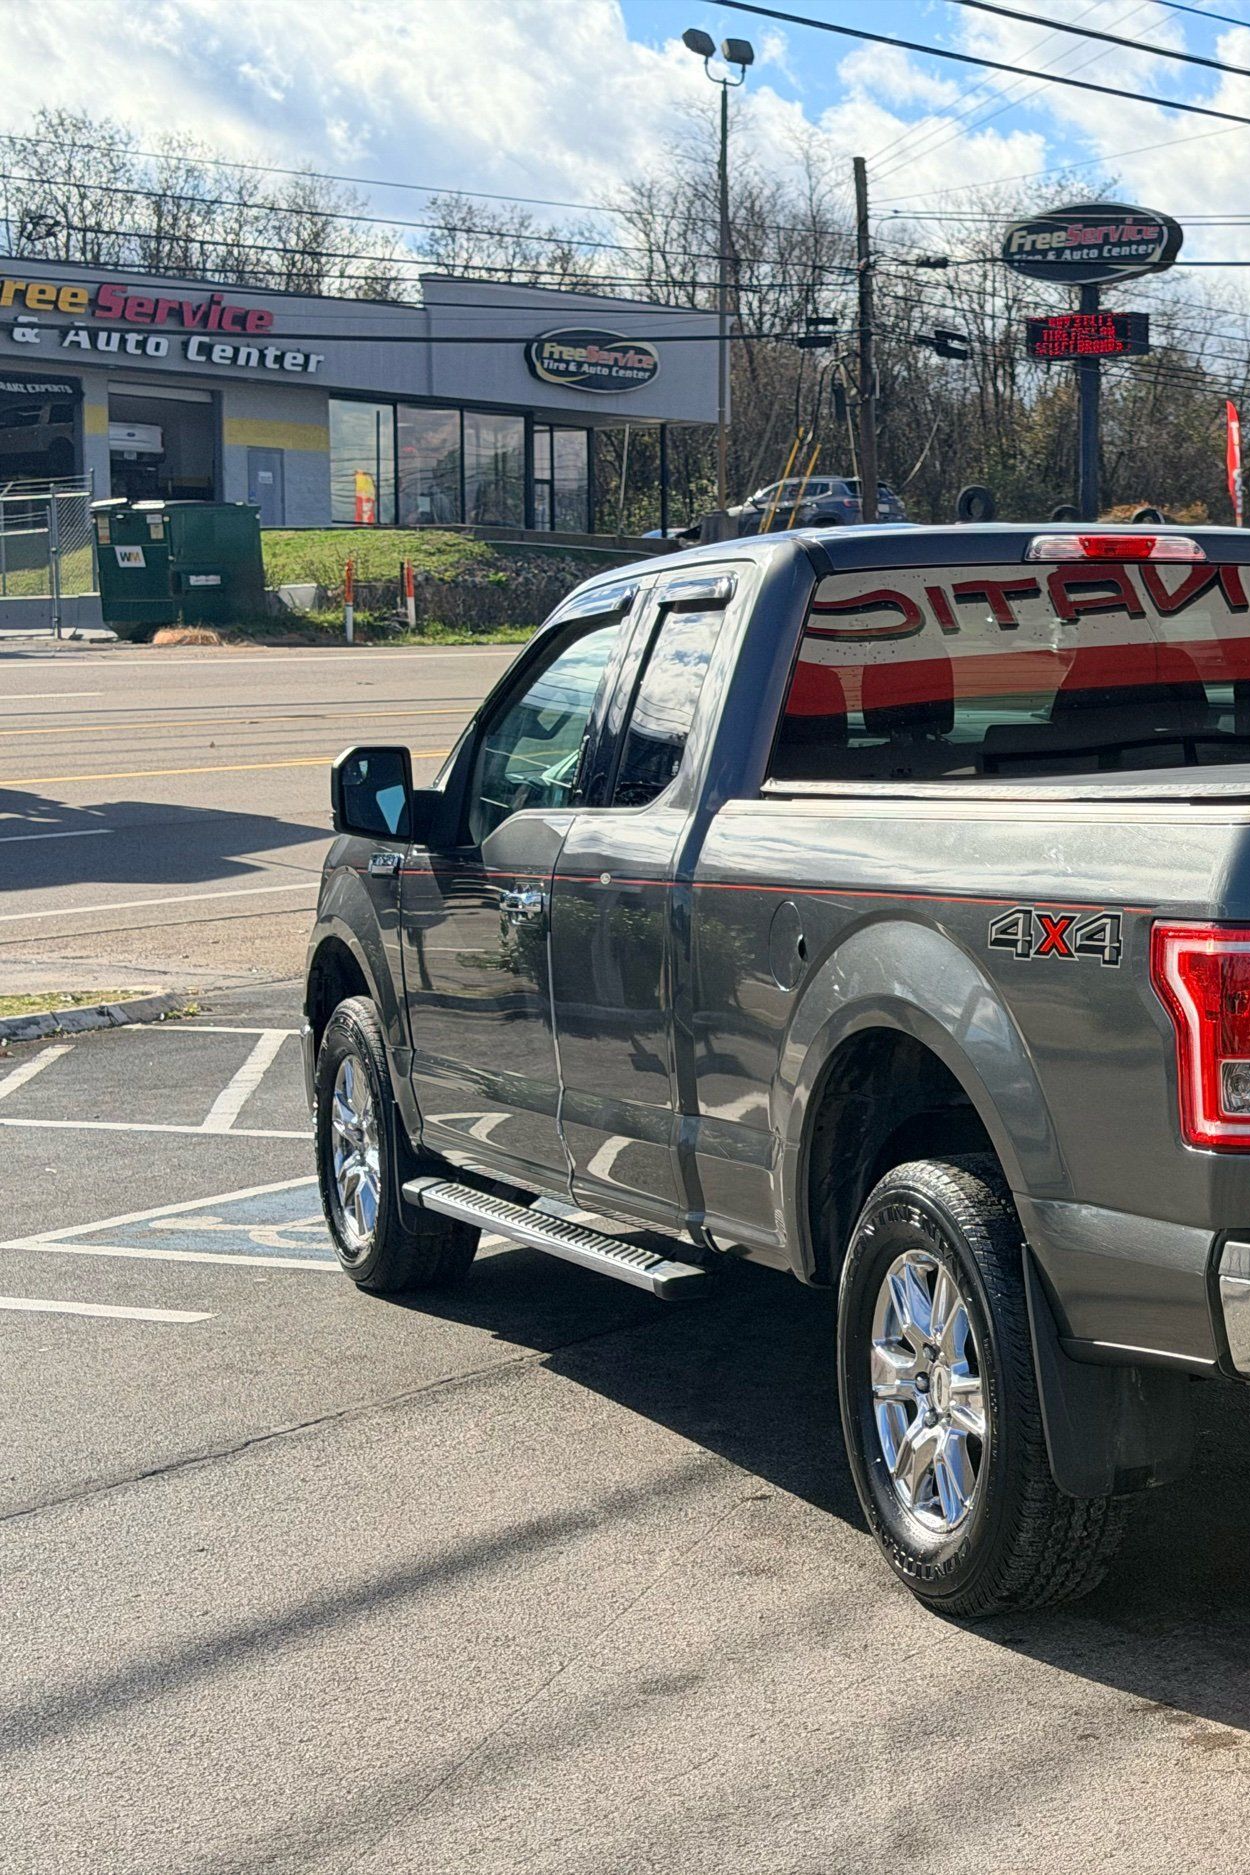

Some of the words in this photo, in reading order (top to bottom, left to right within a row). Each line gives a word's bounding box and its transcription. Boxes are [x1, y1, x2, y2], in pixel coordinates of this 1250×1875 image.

[1062, 248, 1098, 260] Auto
[1103, 243, 1154, 257] Center
[12, 315, 41, 344] &
[62, 322, 169, 357] Auto
[186, 336, 326, 373] Center
[542, 359, 567, 370] Tire
[568, 361, 577, 371] &
[581, 364, 609, 375] Auto
[611, 368, 650, 379] Center
[27, 383, 73, 393] EXPERTS
[119, 551, 142, 563] WM
